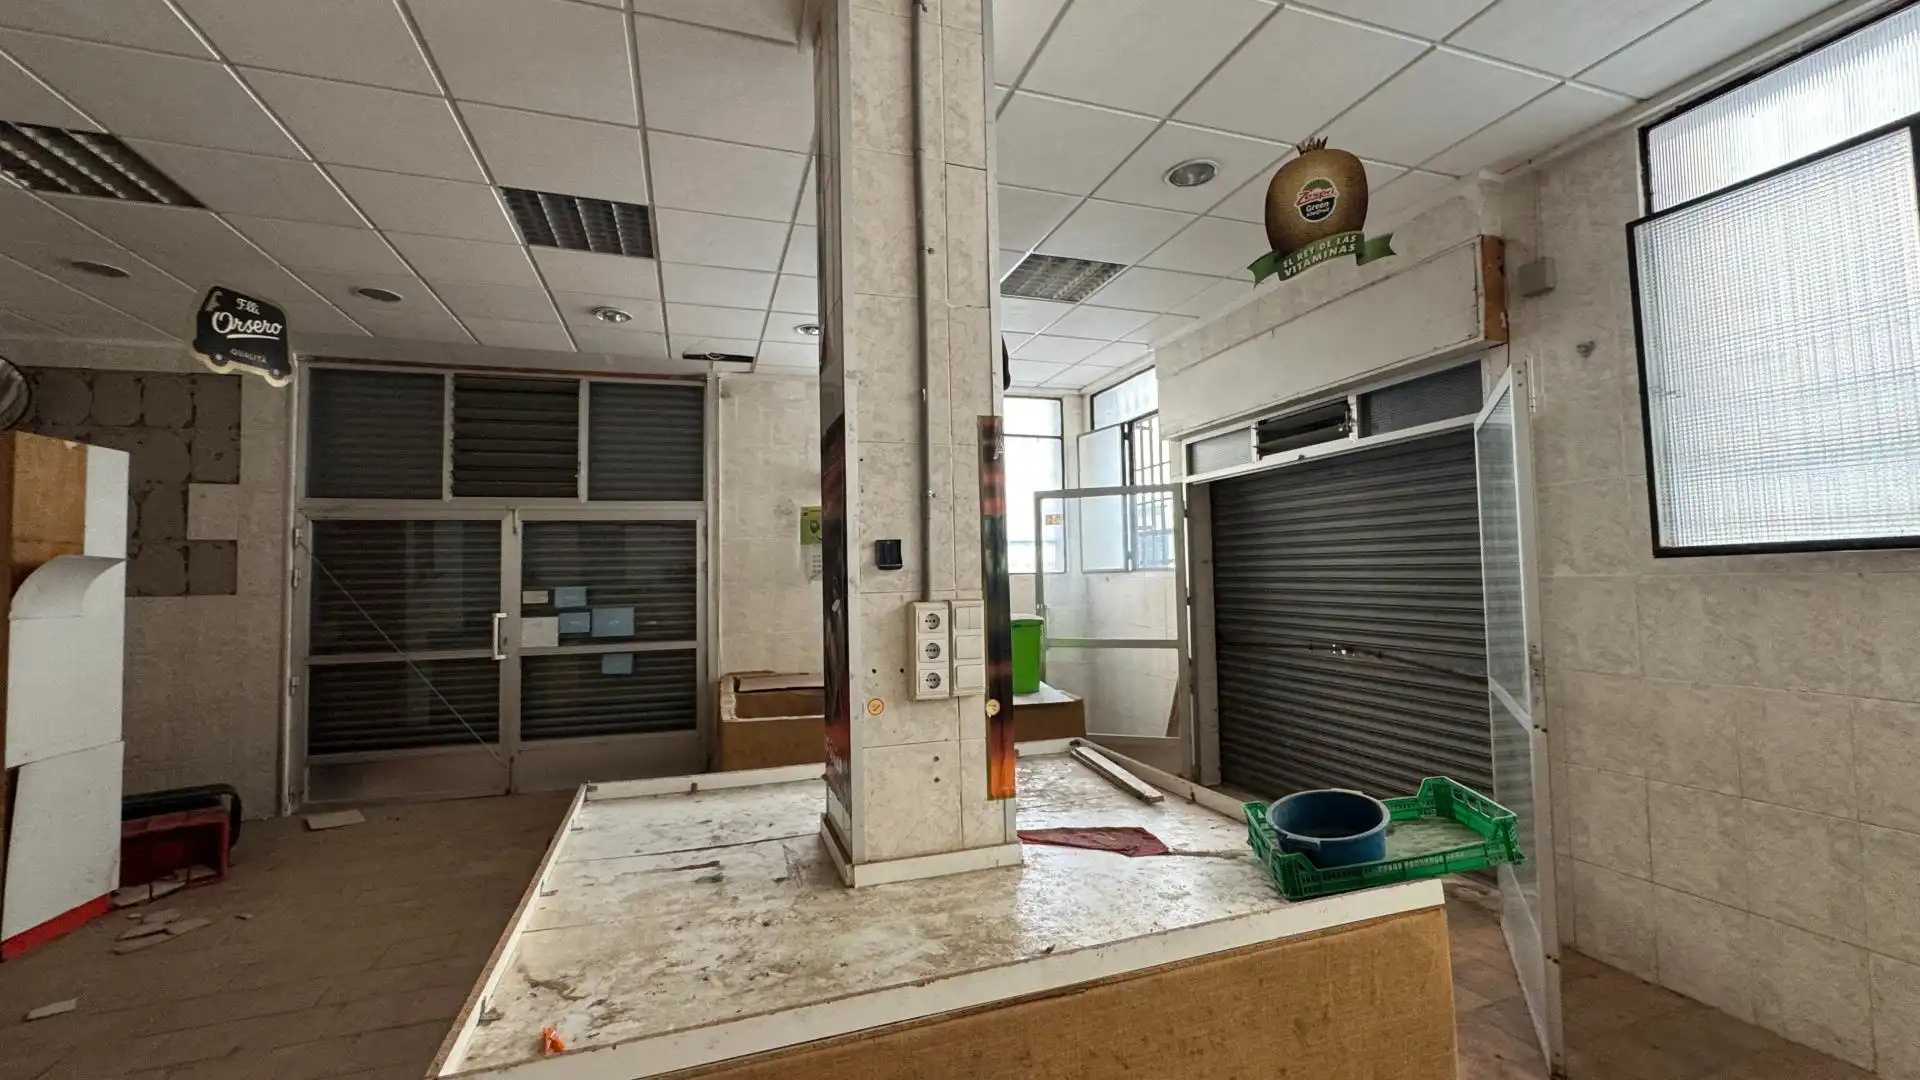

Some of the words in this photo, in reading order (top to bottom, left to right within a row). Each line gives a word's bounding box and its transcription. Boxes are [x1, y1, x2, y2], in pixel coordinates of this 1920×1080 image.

[1306, 201, 1329, 212] Green
[1283, 259, 1293, 268] EL
[1297, 247, 1315, 260] REY
[1320, 239, 1330, 248] DE
[1337, 235, 1356, 244] LAS
[1284, 244, 1355, 277] VITAMINAS
[212, 312, 282, 334] Orsero
